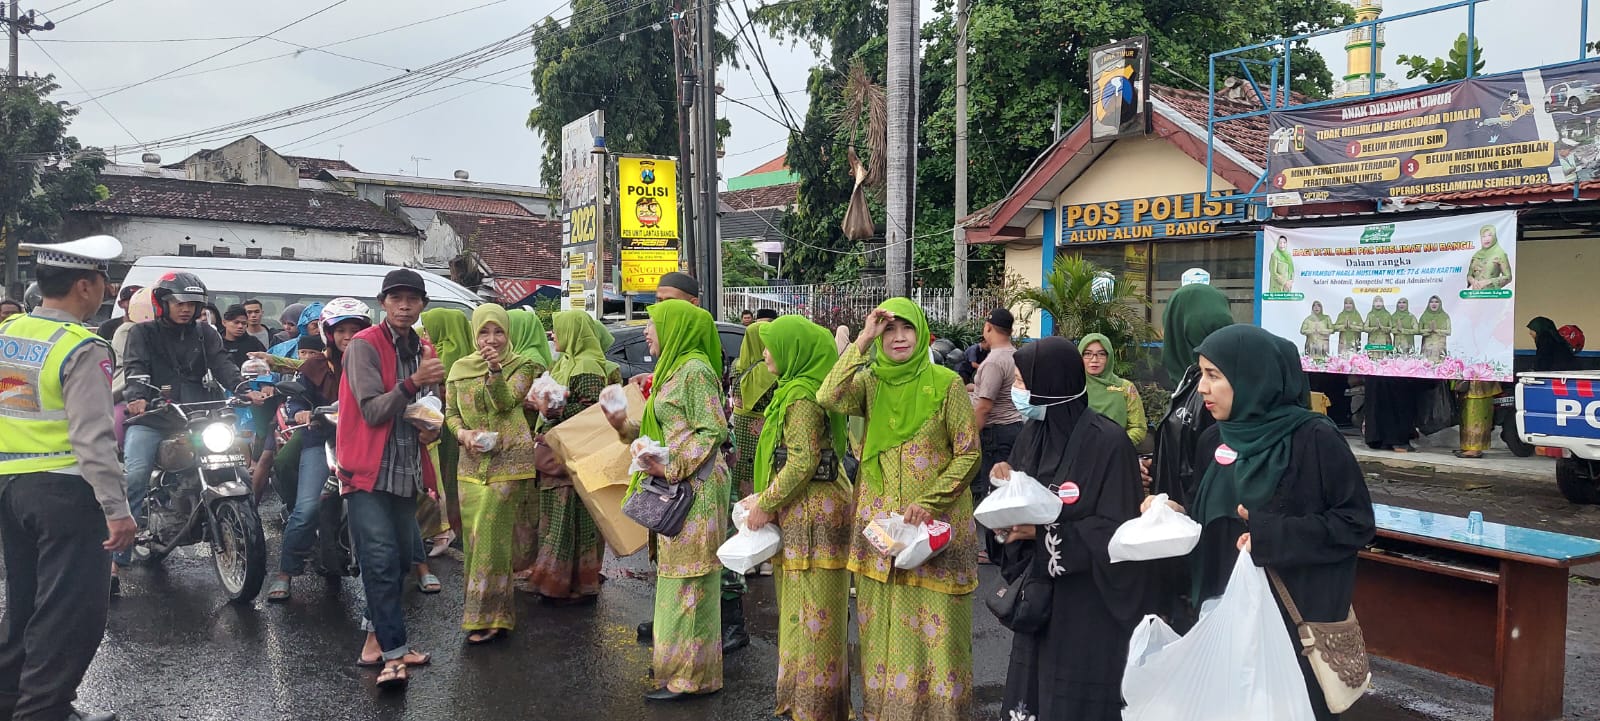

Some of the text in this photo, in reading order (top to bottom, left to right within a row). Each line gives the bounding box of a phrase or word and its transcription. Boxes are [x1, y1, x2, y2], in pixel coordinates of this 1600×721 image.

[1342, 92, 1452, 120] ANAK DIBAWAH UMUR
[1316, 130, 1342, 141] TIDAK
[1384, 113, 1440, 132] BERKENDARA
[1351, 146, 1356, 154] 1
[1362, 134, 1444, 152] BELUM MEMILIKI SIM
[1426, 142, 1549, 164] BELUM MEMILIKI KESTABILAN
[1290, 160, 1398, 178] MINIM PENGETAHUAN TERHADAP
[1408, 162, 1414, 172] 3
[1448, 158, 1522, 174] EMOSI YANG BAIK
[1278, 177, 1282, 186] 2
[1303, 172, 1382, 188] PERATURAN LALU LINTAS
[1389, 173, 1548, 196] OPERASI KESELAMATAN SEMERU 2023
[628, 186, 668, 197] POLISI
[1067, 190, 1234, 229] POS POLISI
[571, 204, 596, 244] 2023
[1070, 220, 1217, 243] ALUN-ALUN BANGI
[1292, 248, 1313, 256] BAGI
[1335, 247, 1357, 256] OLEH
[1358, 246, 1374, 256] PAC
[1376, 244, 1422, 255] MUSLIMAT
[1424, 244, 1438, 252] NU
[1440, 240, 1475, 252] BANGIL
[1346, 257, 1411, 267] Dalam rangka
[1556, 398, 1600, 429] PO
